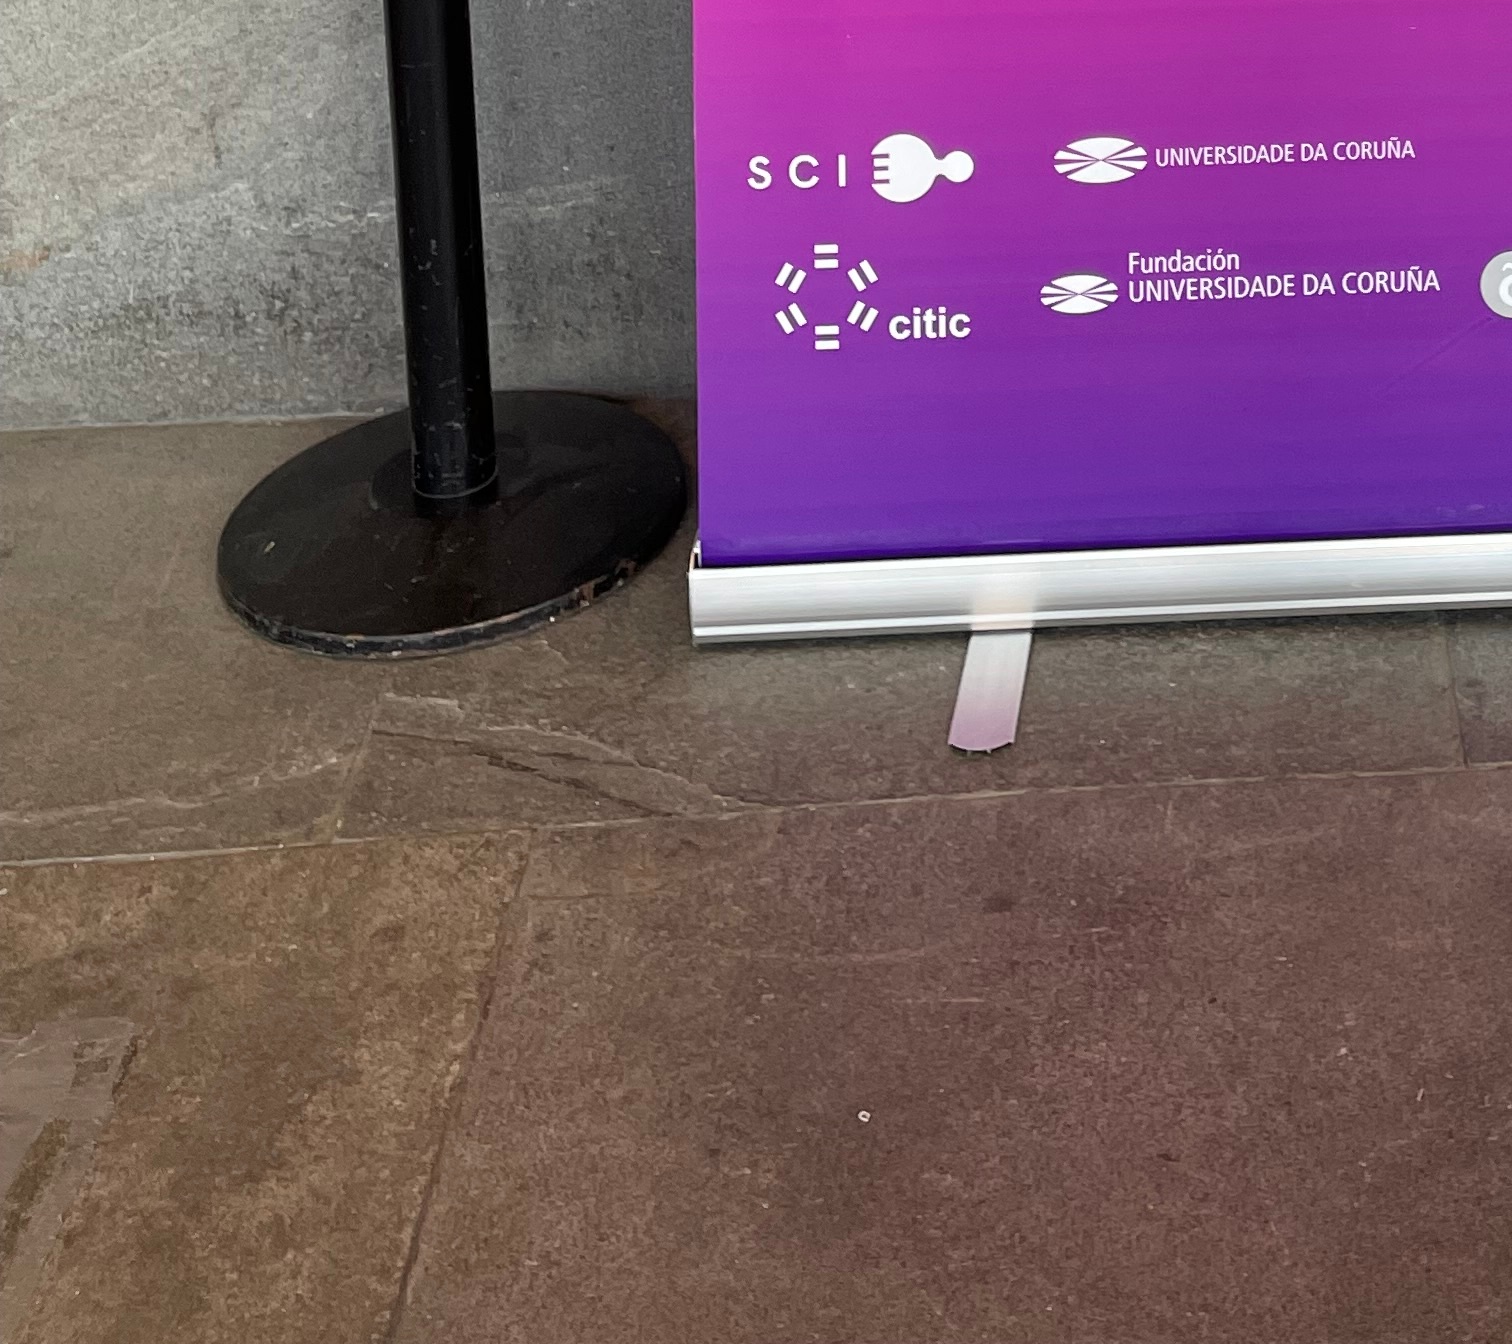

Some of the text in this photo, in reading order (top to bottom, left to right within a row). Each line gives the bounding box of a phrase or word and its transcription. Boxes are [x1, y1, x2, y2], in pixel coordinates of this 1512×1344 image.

[1155, 136, 1416, 167] UNIVERSIDADE DA CORUÑA
[1128, 248, 1241, 275] Fundación
[1128, 265, 1441, 303] UNIVERSIDADE DA CORUÑA
[888, 306, 972, 341] citic
